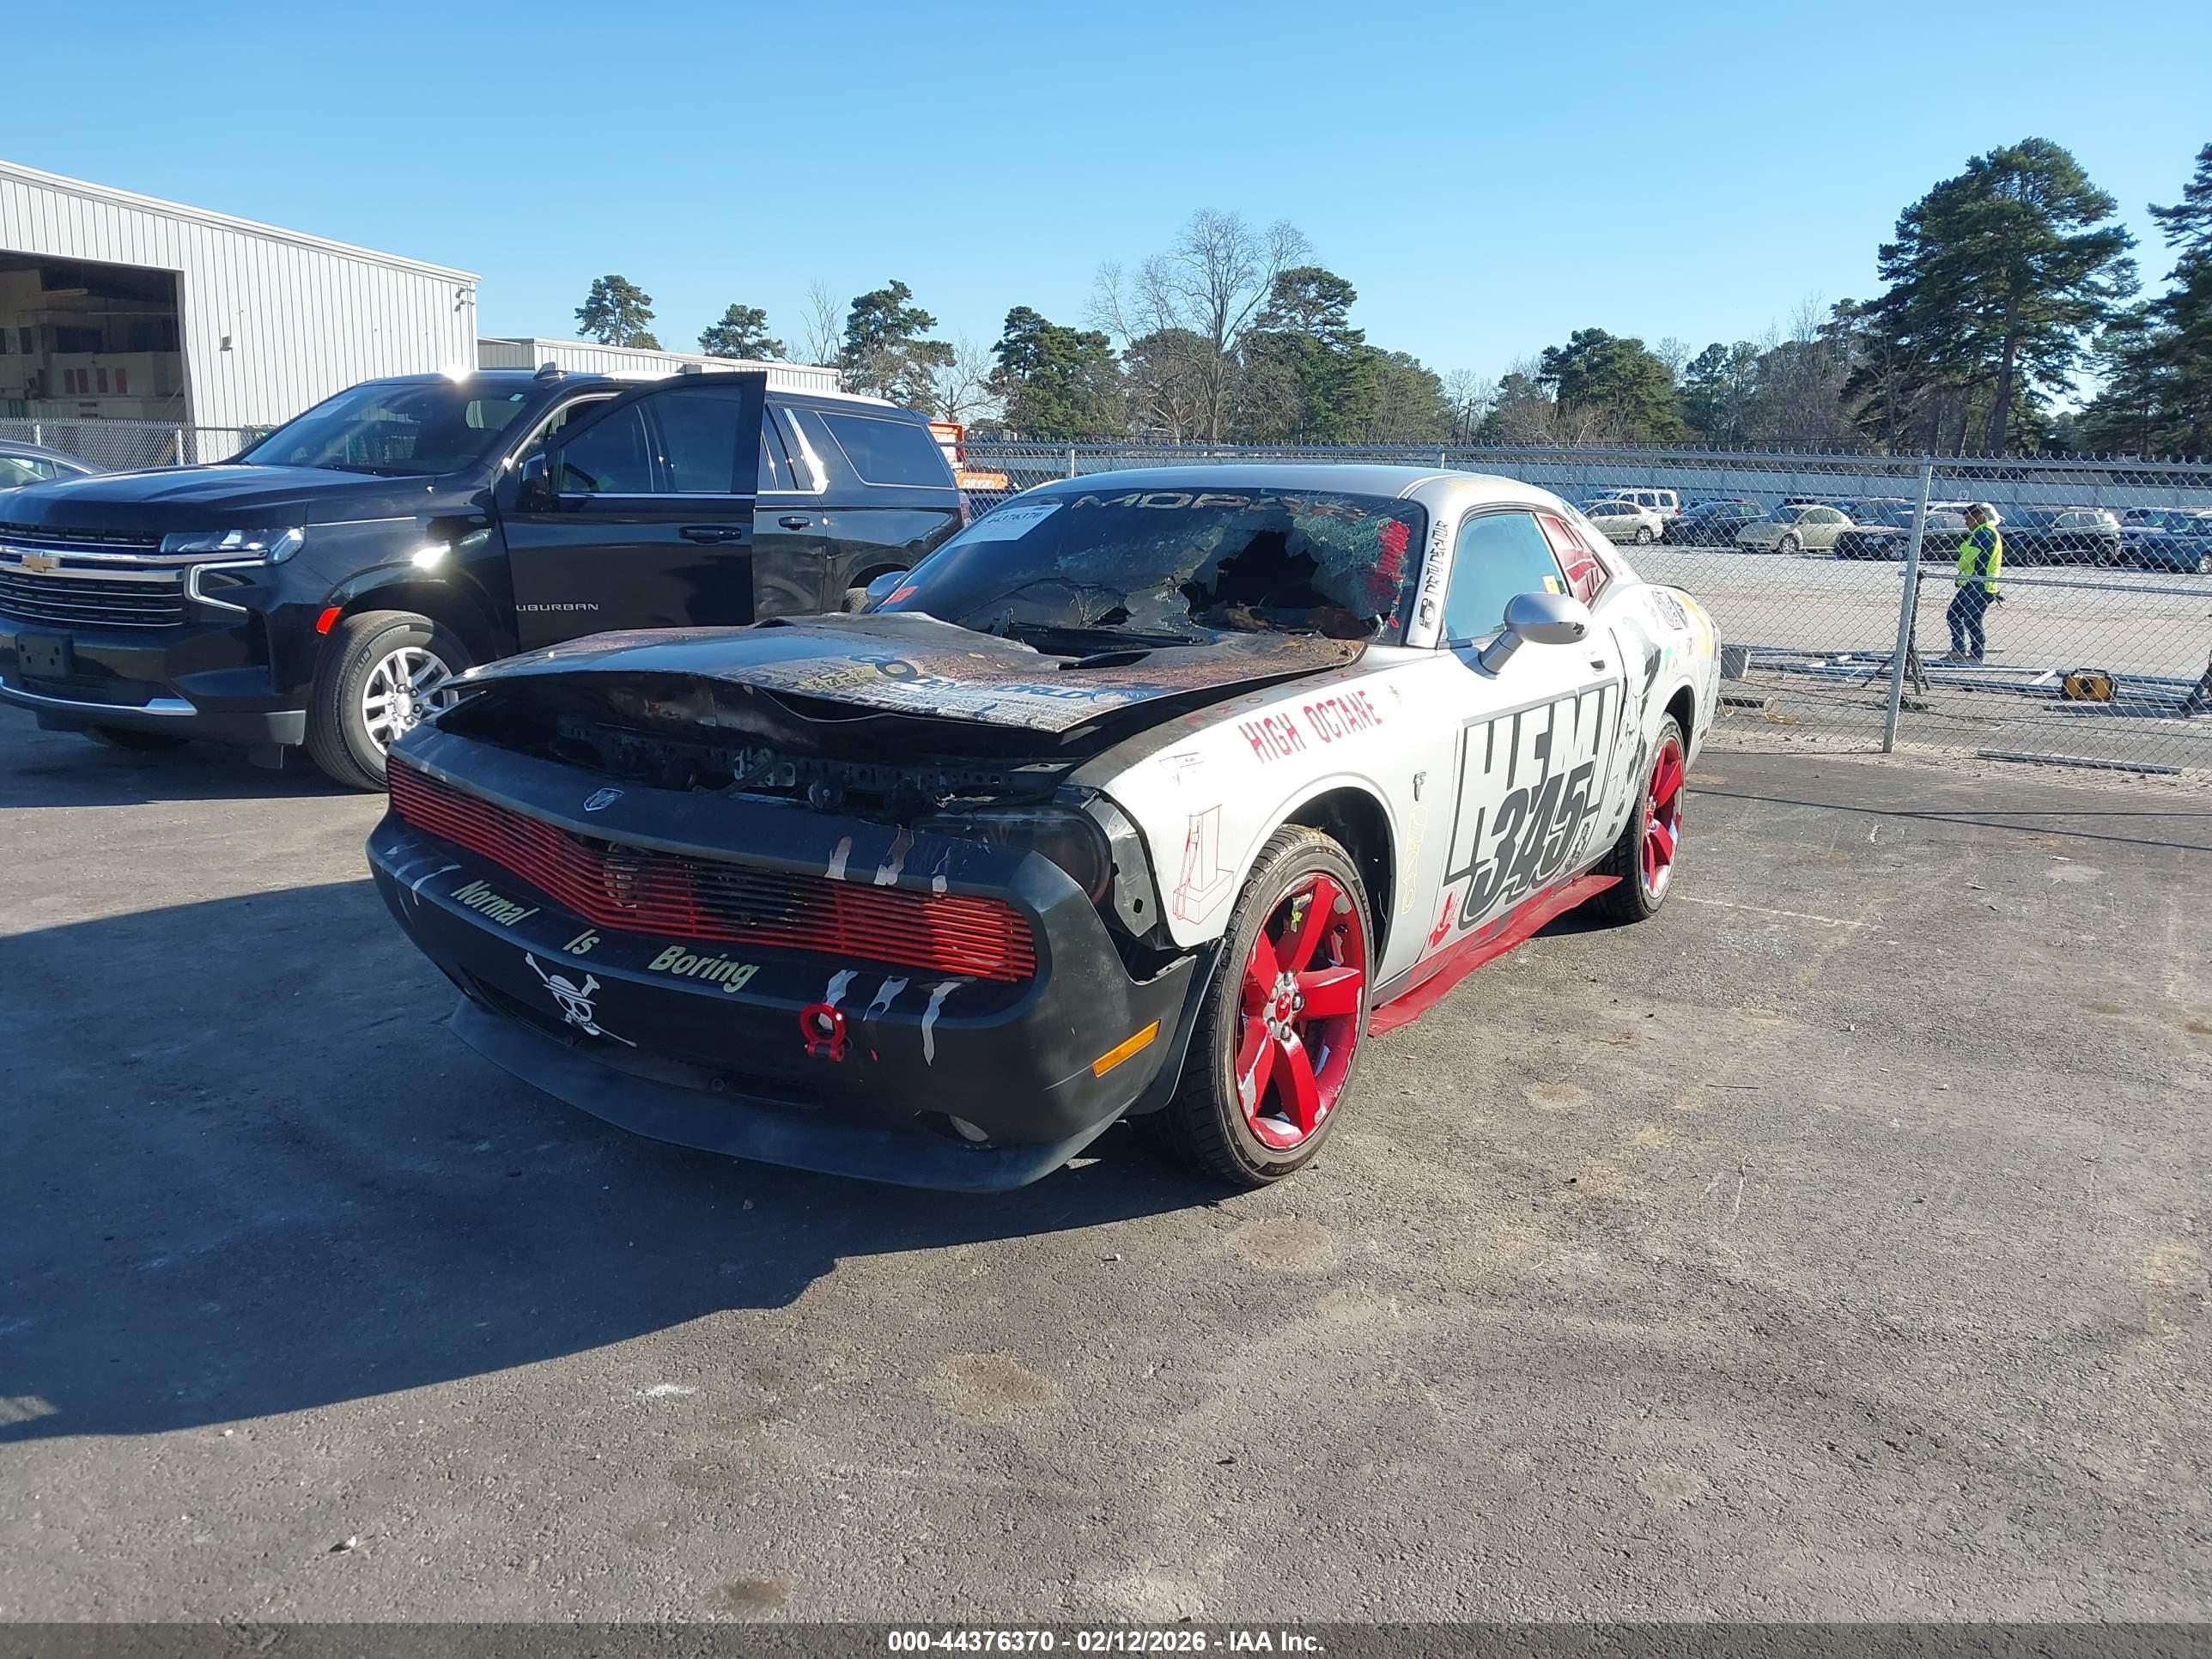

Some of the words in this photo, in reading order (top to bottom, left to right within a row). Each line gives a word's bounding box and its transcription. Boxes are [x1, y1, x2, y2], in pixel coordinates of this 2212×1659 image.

[514, 603, 599, 611] UBURBAN
[1238, 713, 1307, 763] HIGH
[1304, 690, 1382, 744] OCTANE
[1443, 678, 1620, 887] HEMI
[1458, 761, 1595, 930] 345
[449, 879, 540, 927] Normal
[562, 928, 600, 956] Is
[647, 945, 761, 994] Boring
